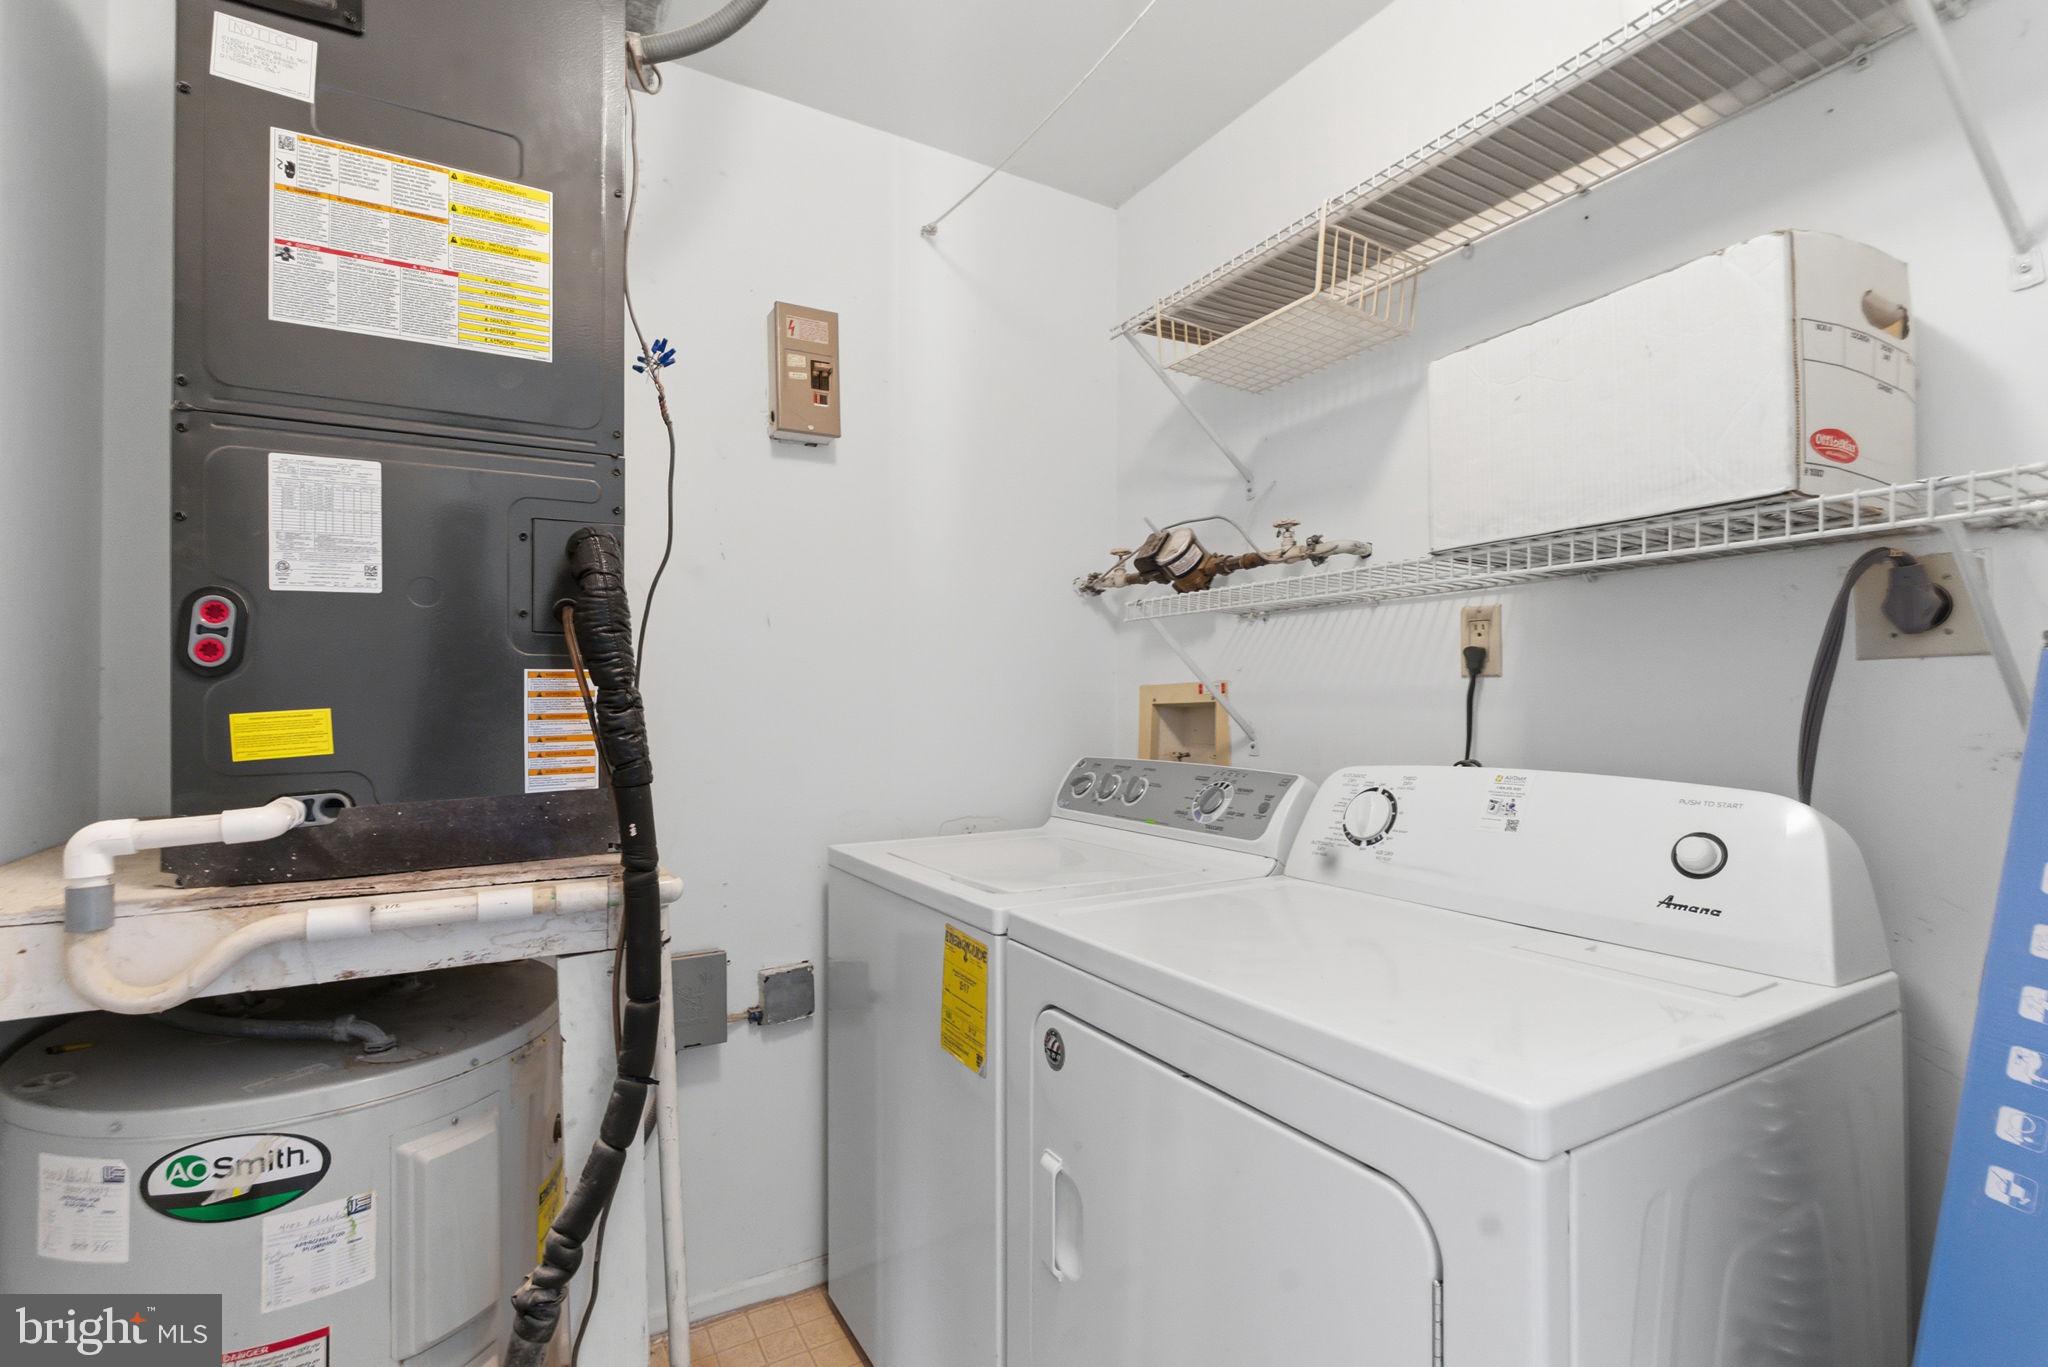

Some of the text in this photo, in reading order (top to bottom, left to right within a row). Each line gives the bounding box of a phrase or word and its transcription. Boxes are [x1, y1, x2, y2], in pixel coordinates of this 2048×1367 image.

[233, 21, 296, 51] NOTICE
[1678, 798, 1745, 809] PUSH TO START
[1656, 894, 1723, 917] Amana
